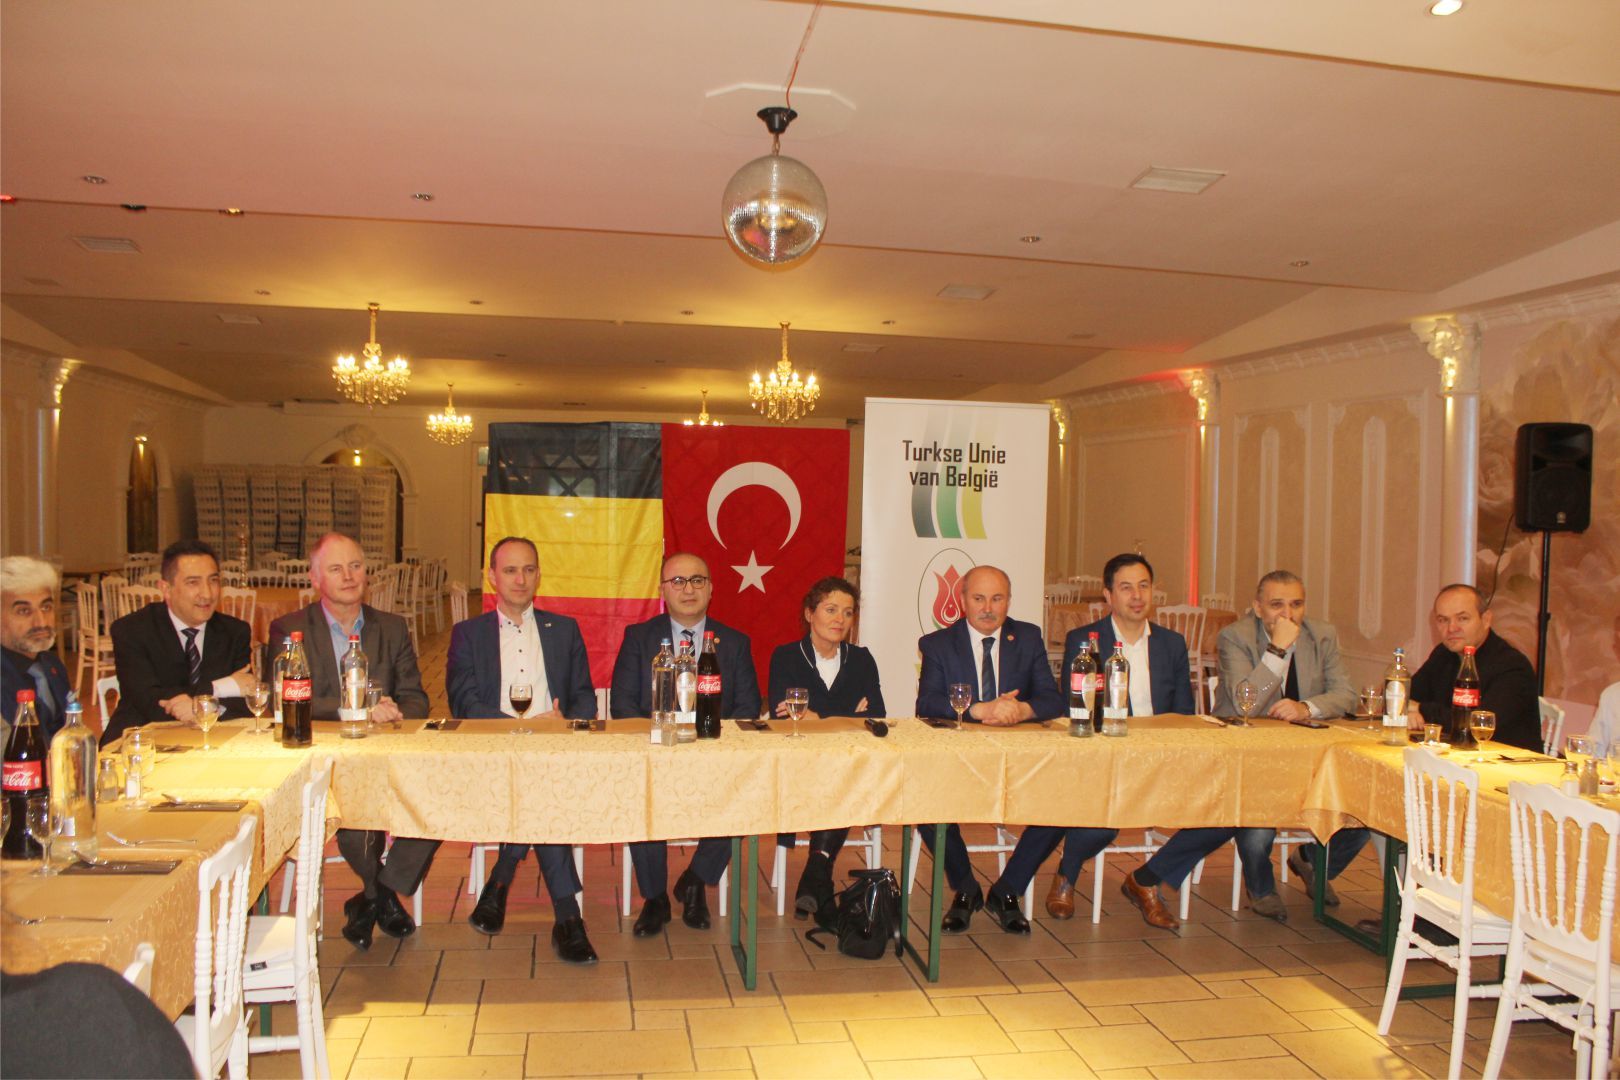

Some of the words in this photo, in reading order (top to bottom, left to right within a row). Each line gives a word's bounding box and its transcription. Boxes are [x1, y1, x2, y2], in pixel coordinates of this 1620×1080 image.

[902, 439, 963, 463] Turkse
[968, 442, 1006, 464] Unie
[909, 471, 940, 486] van
[945, 465, 998, 492] België
